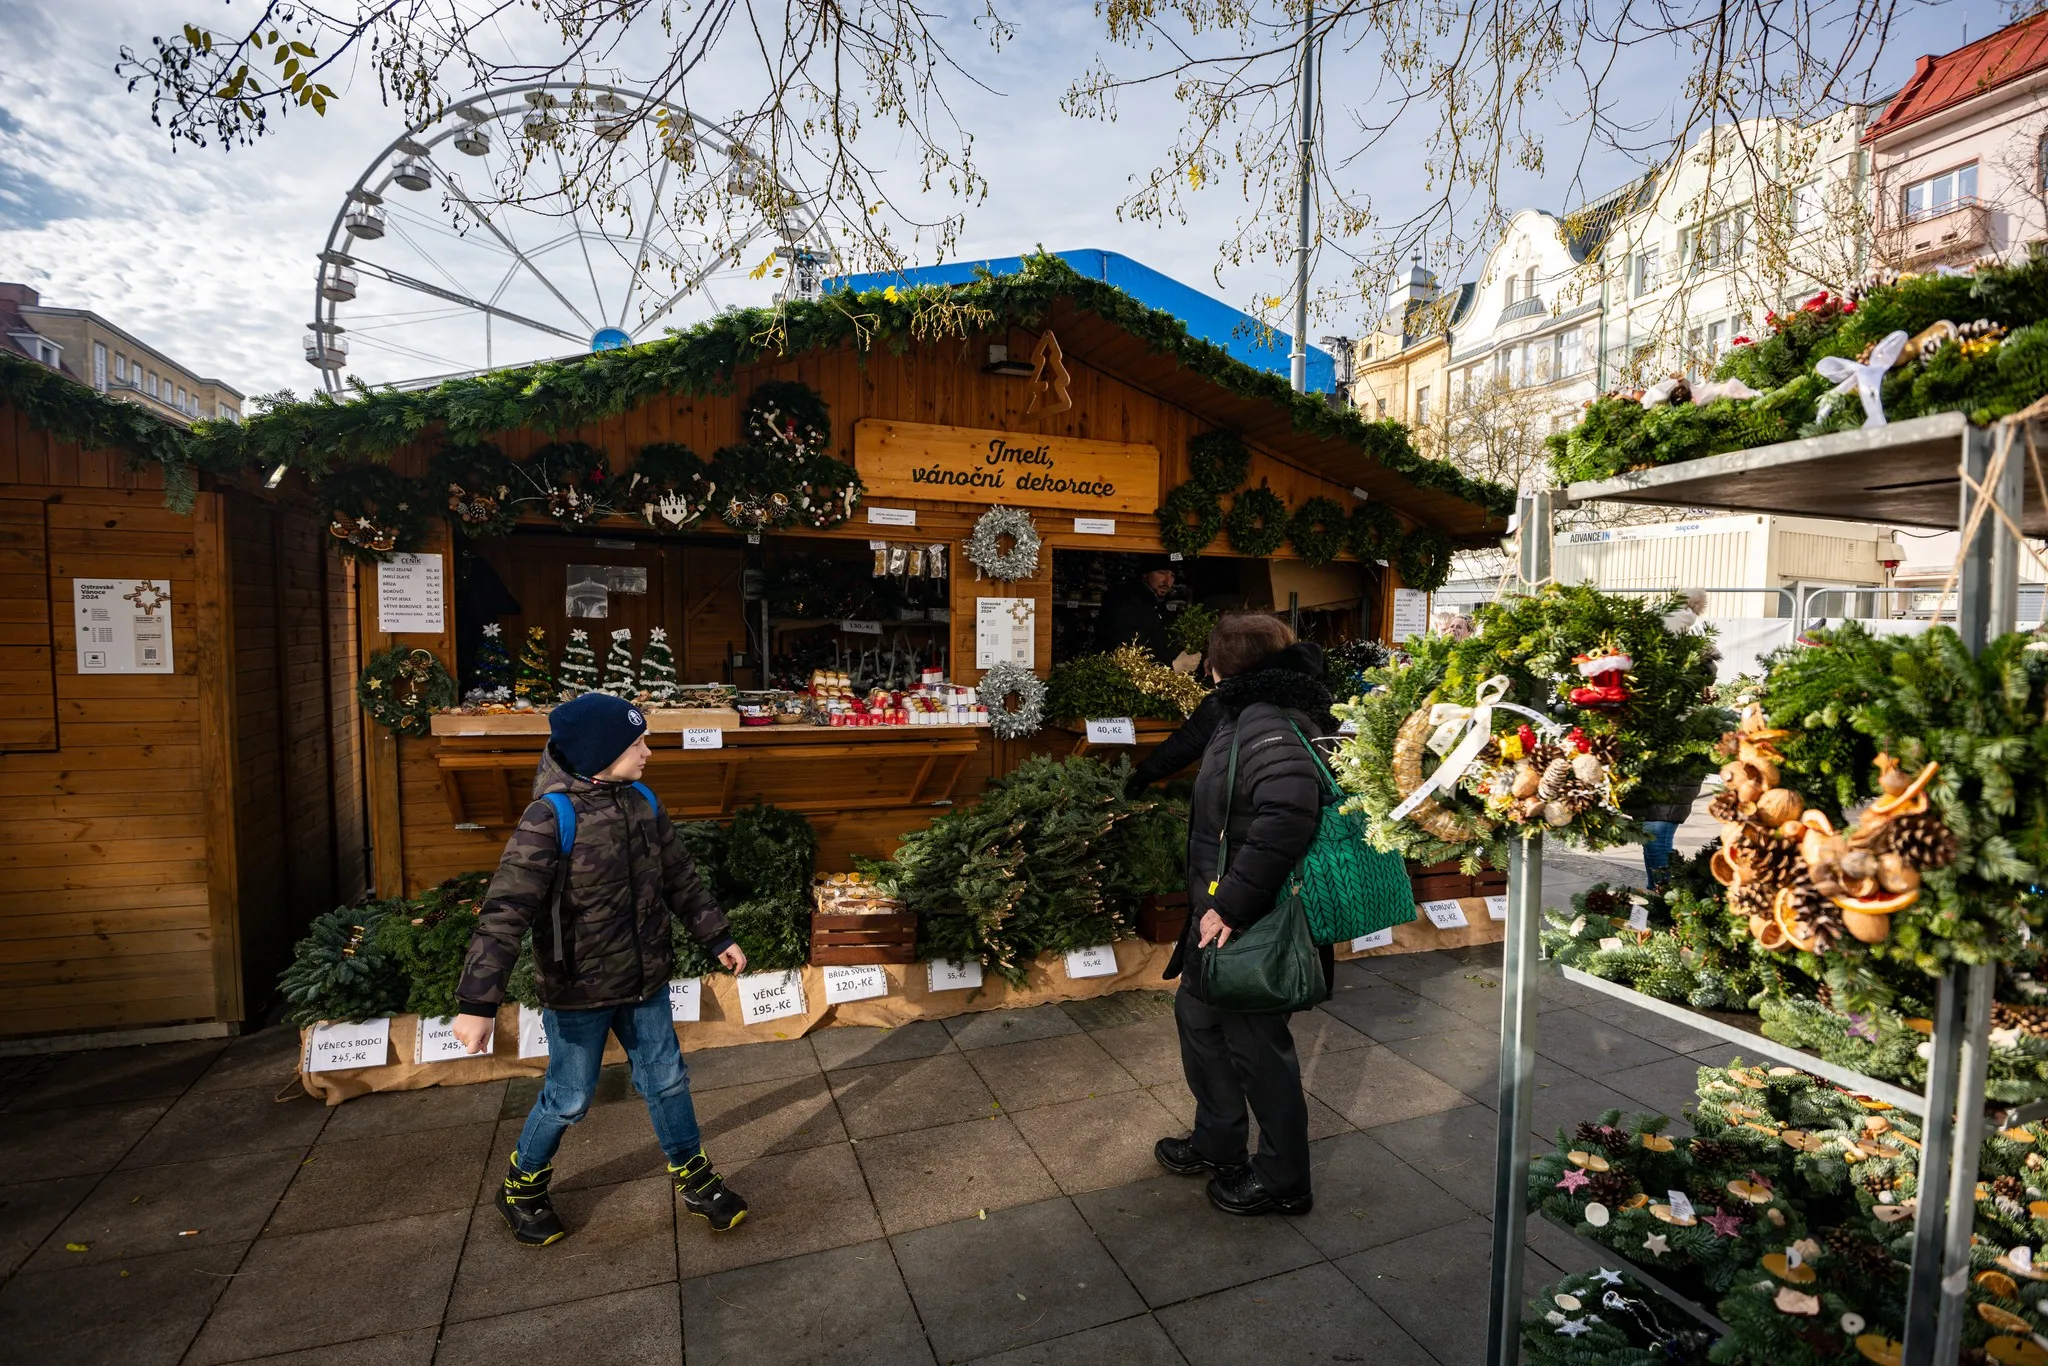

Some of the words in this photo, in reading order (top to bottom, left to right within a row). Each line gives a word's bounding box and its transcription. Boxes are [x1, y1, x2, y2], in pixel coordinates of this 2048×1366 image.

[986, 439, 1055, 470] Jmelí,
[912, 463, 1005, 488] vánoční
[1016, 471, 1116, 497] dekorace
[1096, 726, 1122, 734] 40,-Kč
[1437, 913, 1457, 922] 55,-Kč
[1365, 934, 1381, 943] 40,-Kč
[1083, 958, 1101, 968] 55,-Kč
[828, 968, 850, 979] BŘÍZA
[947, 971, 966, 980] 55,-Kč
[669, 985, 689, 994] NEC
[836, 976, 874, 992] 120,-Kč
[753, 985, 786, 1001] VĚNCE
[670, 1000, 684, 1011] 5,-
[752, 999, 792, 1016] 195,-Kč
[428, 1030, 453, 1039] VĚNEC
[318, 1041, 346, 1050] VĚNEC
[355, 1037, 382, 1047] BODCI
[331, 1051, 367, 1063] 245,-Kč
